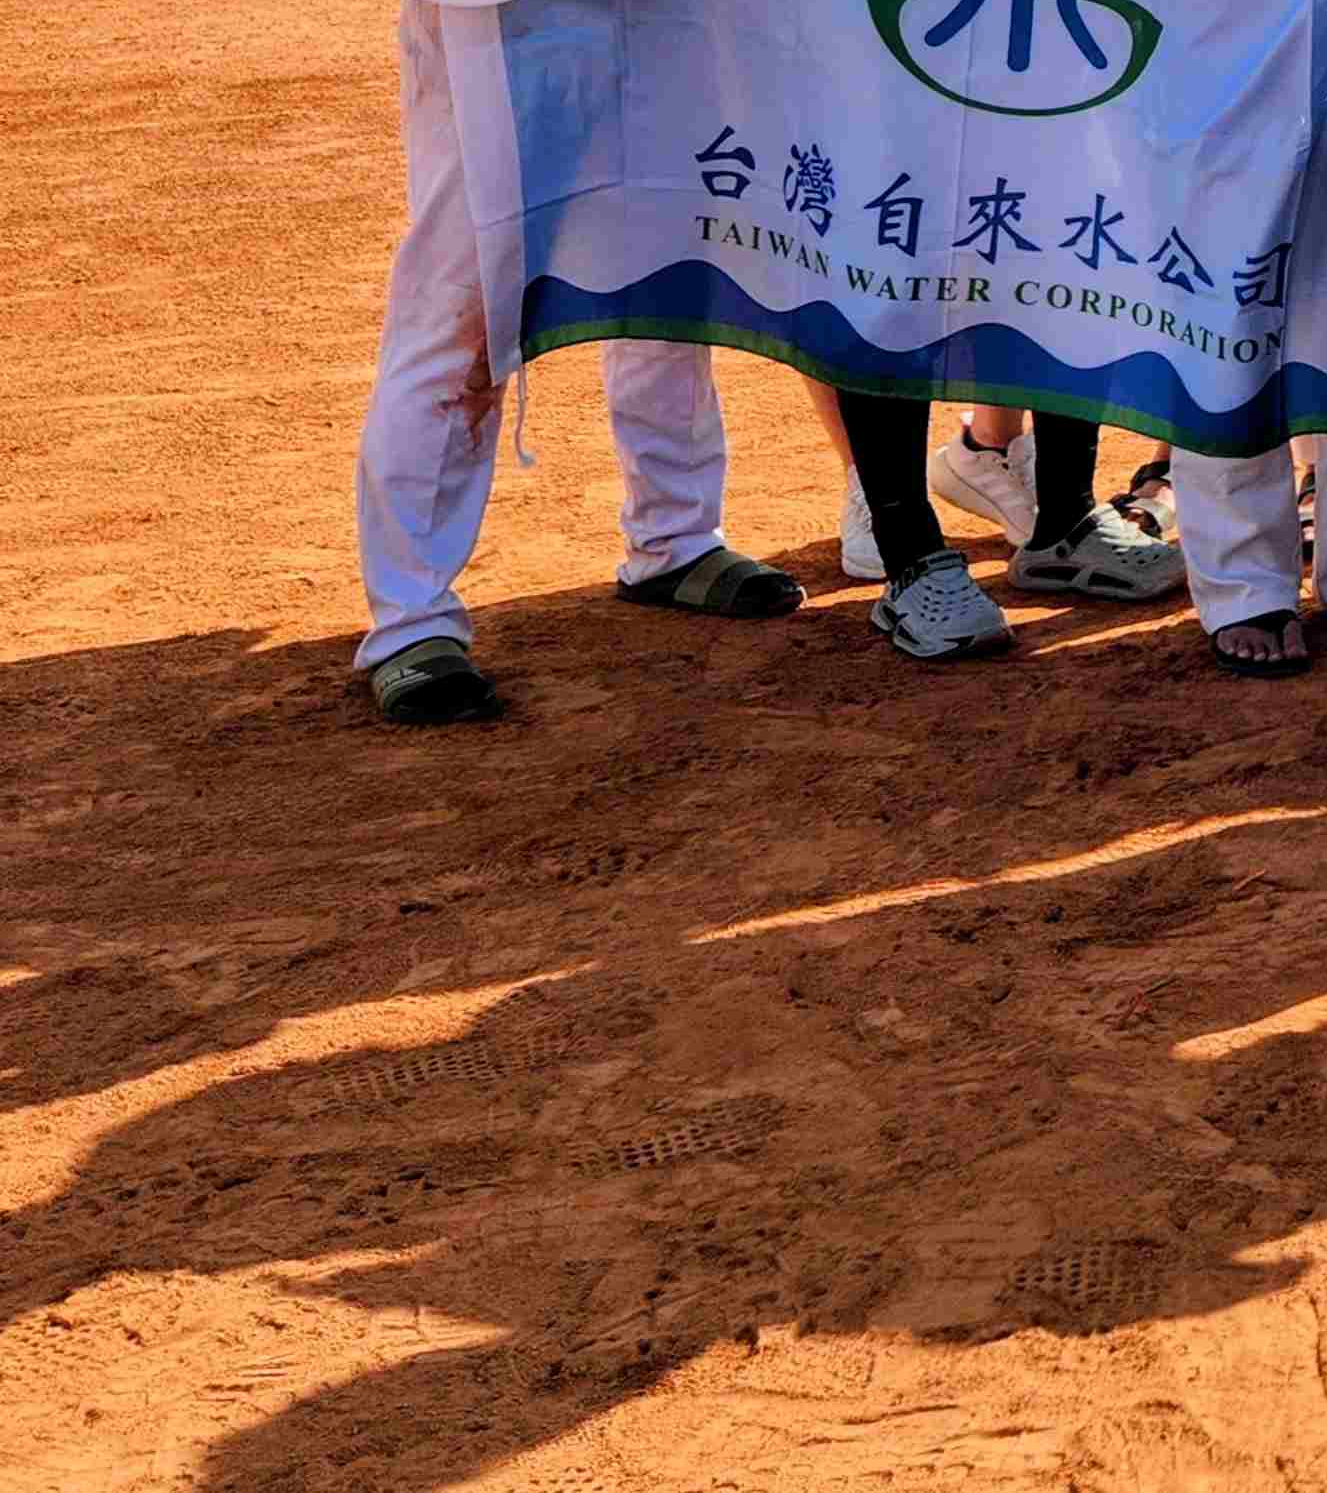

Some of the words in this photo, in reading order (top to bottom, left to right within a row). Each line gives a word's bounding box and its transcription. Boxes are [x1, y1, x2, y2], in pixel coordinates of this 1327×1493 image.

[695, 125, 1293, 309] 台灣自來水公司
[695, 216, 831, 279] TAIWAN
[846, 264, 992, 302] WATER
